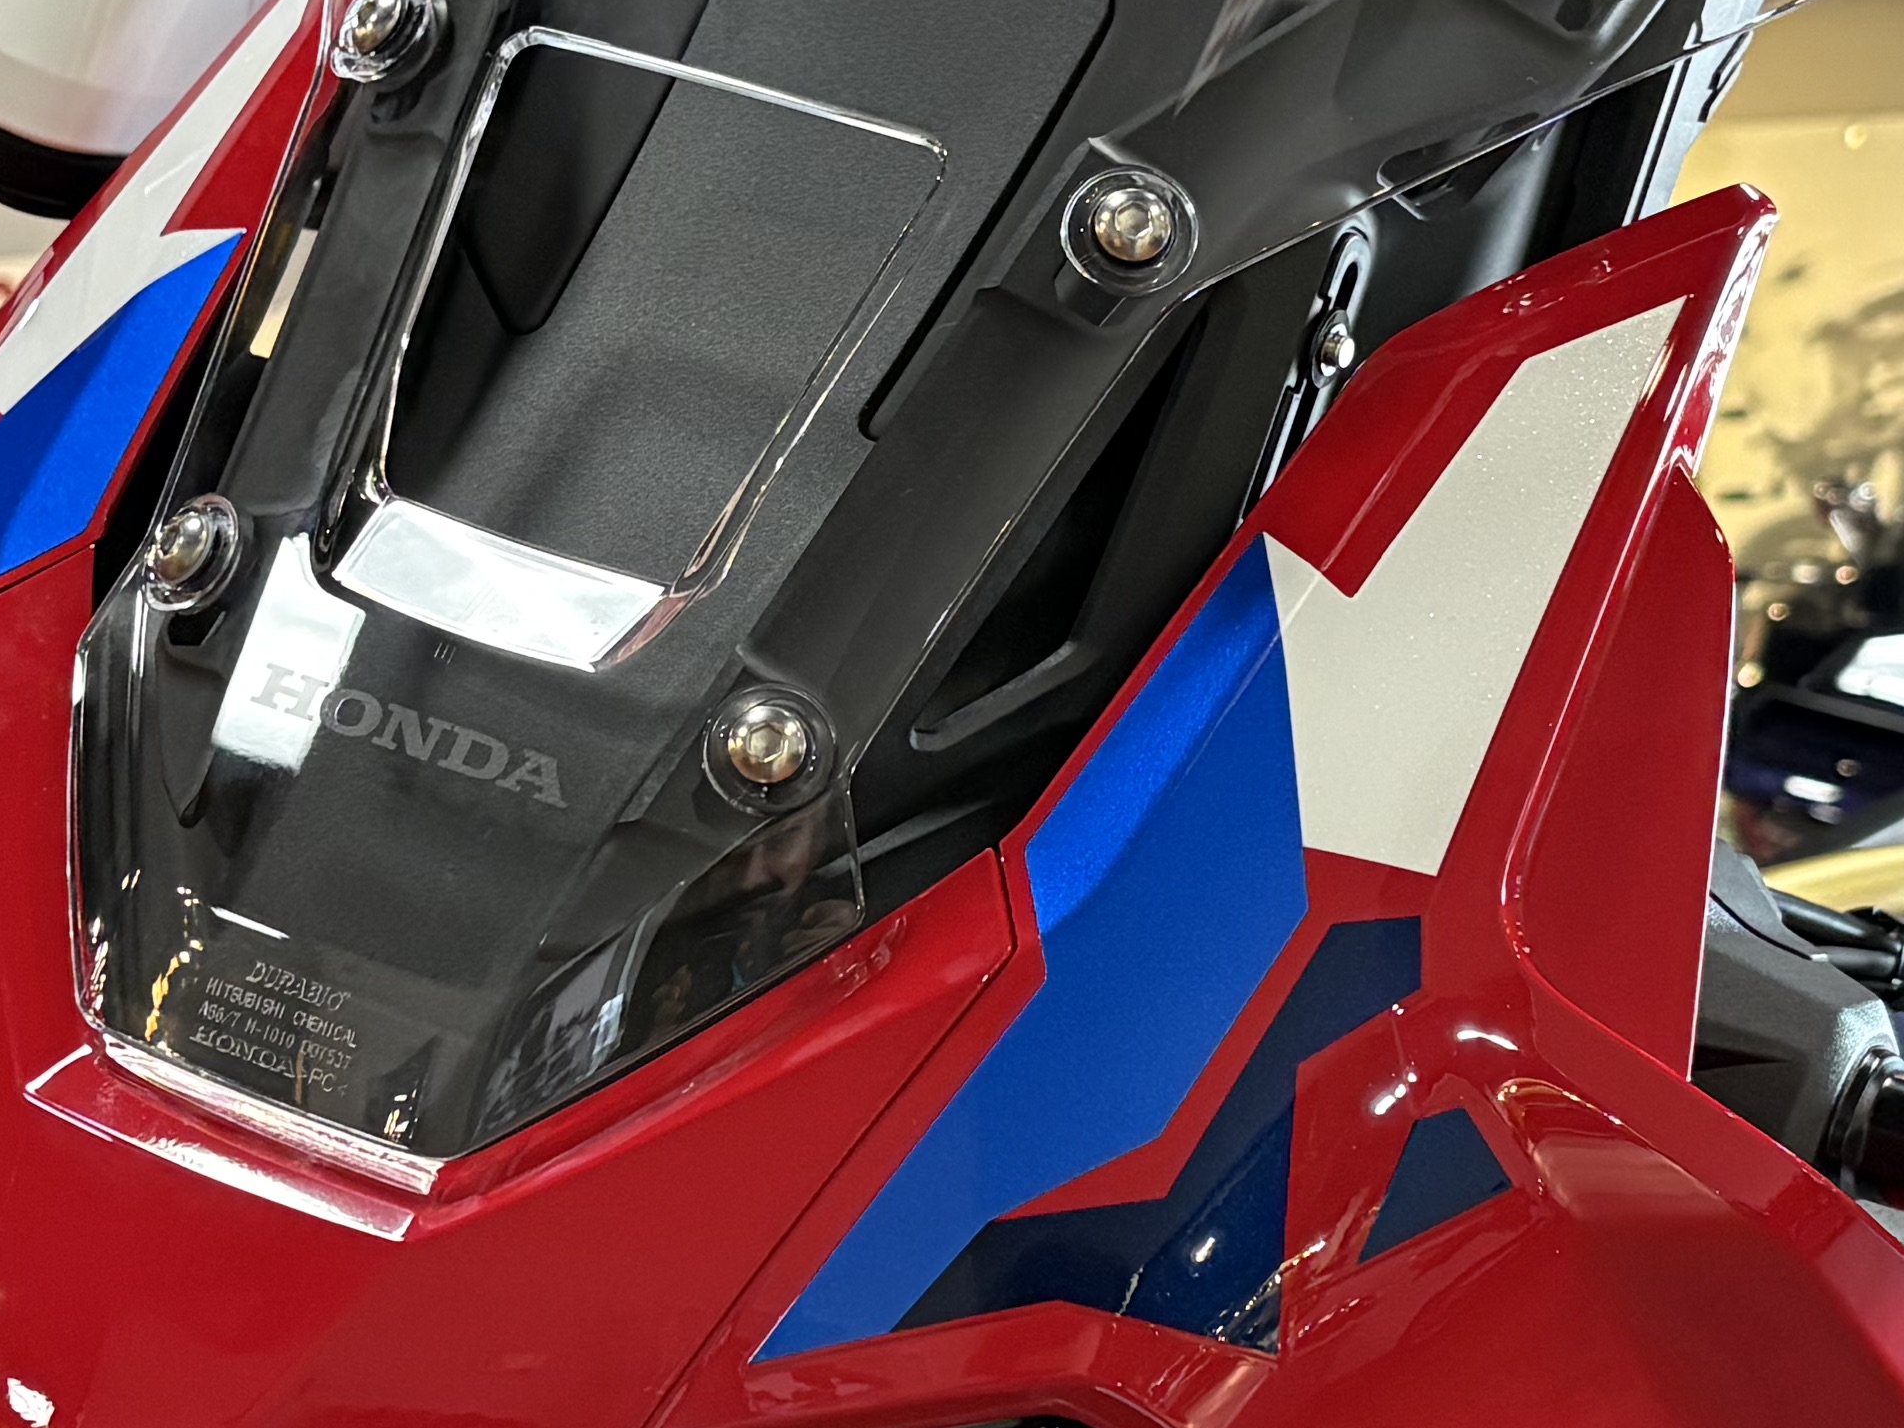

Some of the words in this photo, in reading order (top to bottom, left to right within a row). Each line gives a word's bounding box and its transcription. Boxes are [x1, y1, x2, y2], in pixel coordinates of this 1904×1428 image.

[249, 662, 569, 809] HONDA
[188, 1024, 296, 1079] HONDA
[292, 1009, 358, 1049] CHEMICAL
